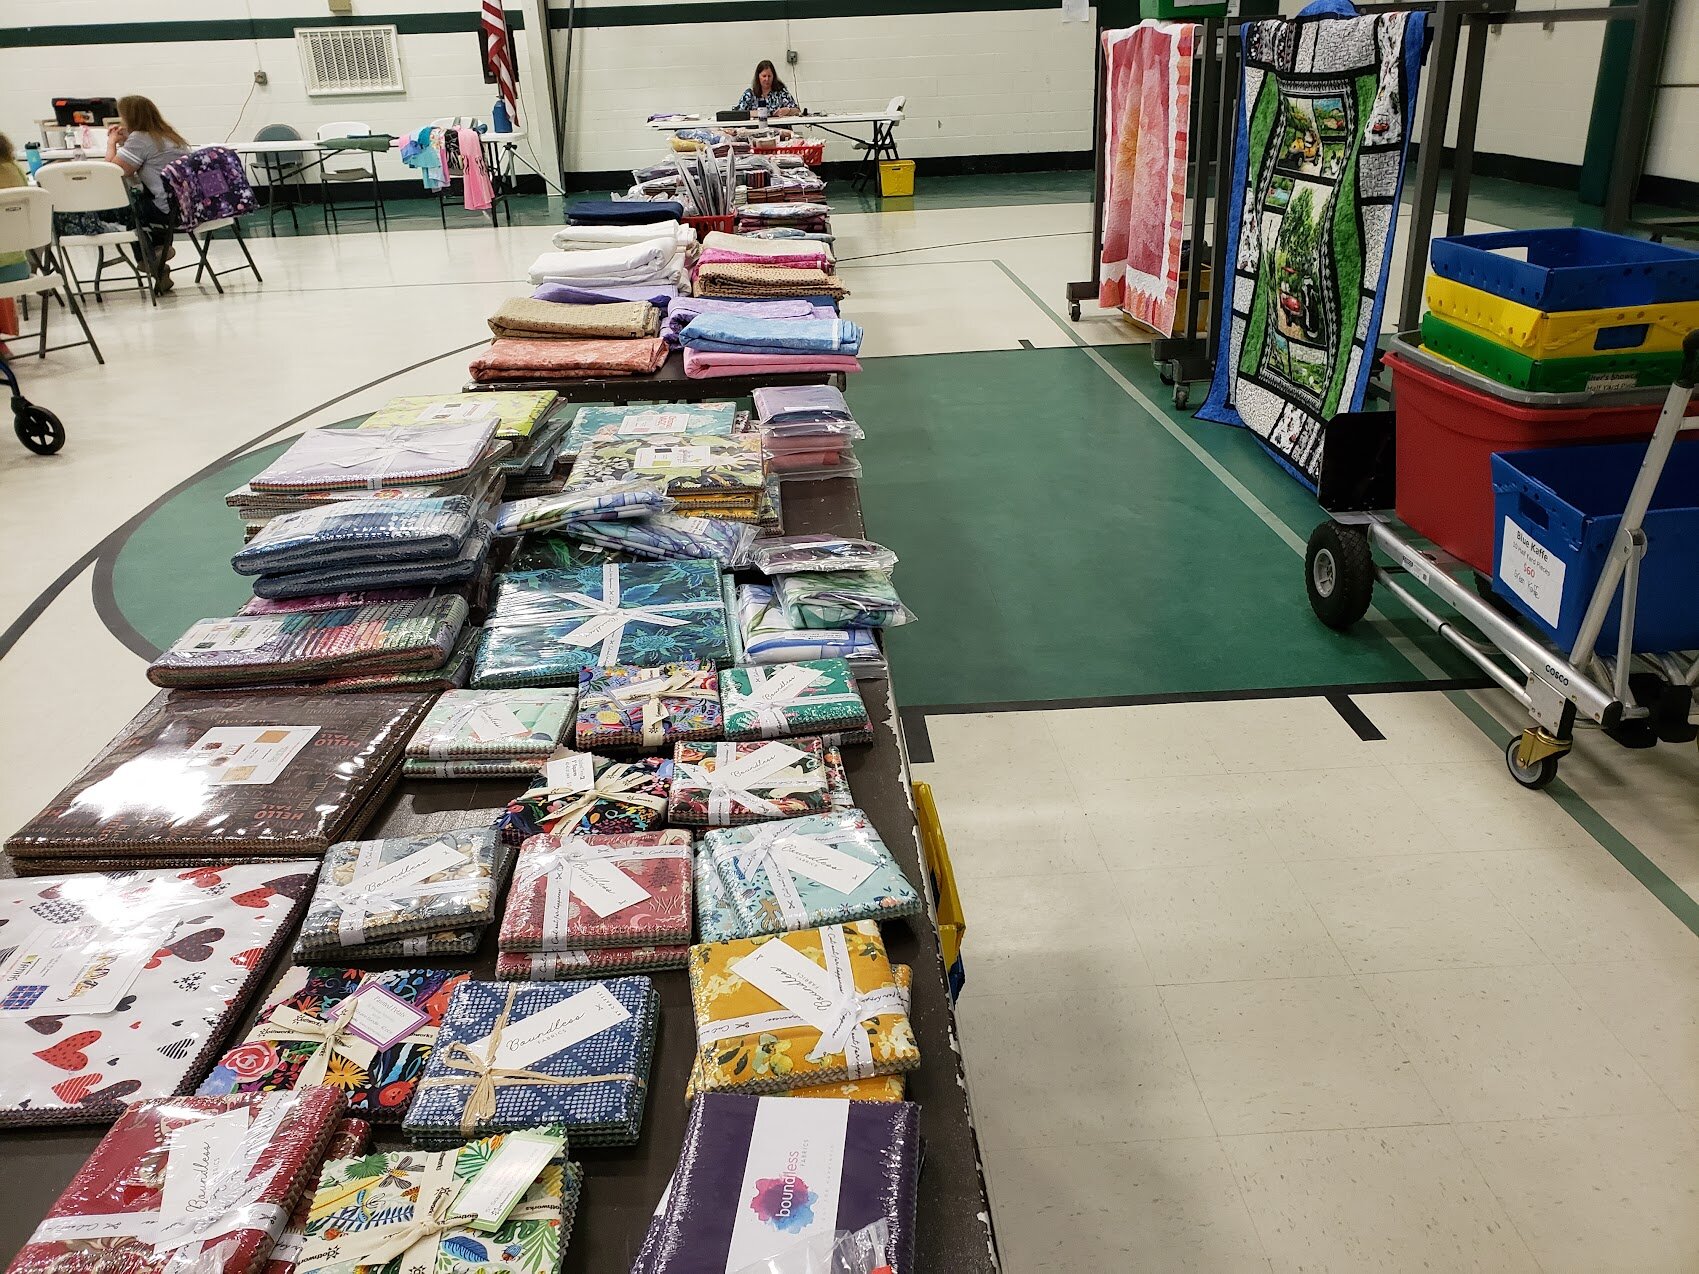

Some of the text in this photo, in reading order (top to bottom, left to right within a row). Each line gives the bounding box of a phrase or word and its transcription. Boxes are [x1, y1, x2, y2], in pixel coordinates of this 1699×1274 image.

[1516, 530, 1549, 563] Blue Kaffe
[1523, 562, 1536, 578] $60
[1545, 664, 1569, 686] COSCO
[314, 738, 361, 748] HELLO
[254, 810, 304, 821] HELLO
[262, 803, 292, 811] FALL
[782, 843, 844, 871] Boundless
[364, 858, 431, 892] Boundless
[573, 861, 616, 895] Boundless
[770, 966, 833, 1011] Boundless
[506, 1012, 585, 1052] Boundless
[800, 1139, 809, 1167] FABRICS
[186, 1141, 210, 1213] Boundless
[775, 1150, 800, 1217] boundless
